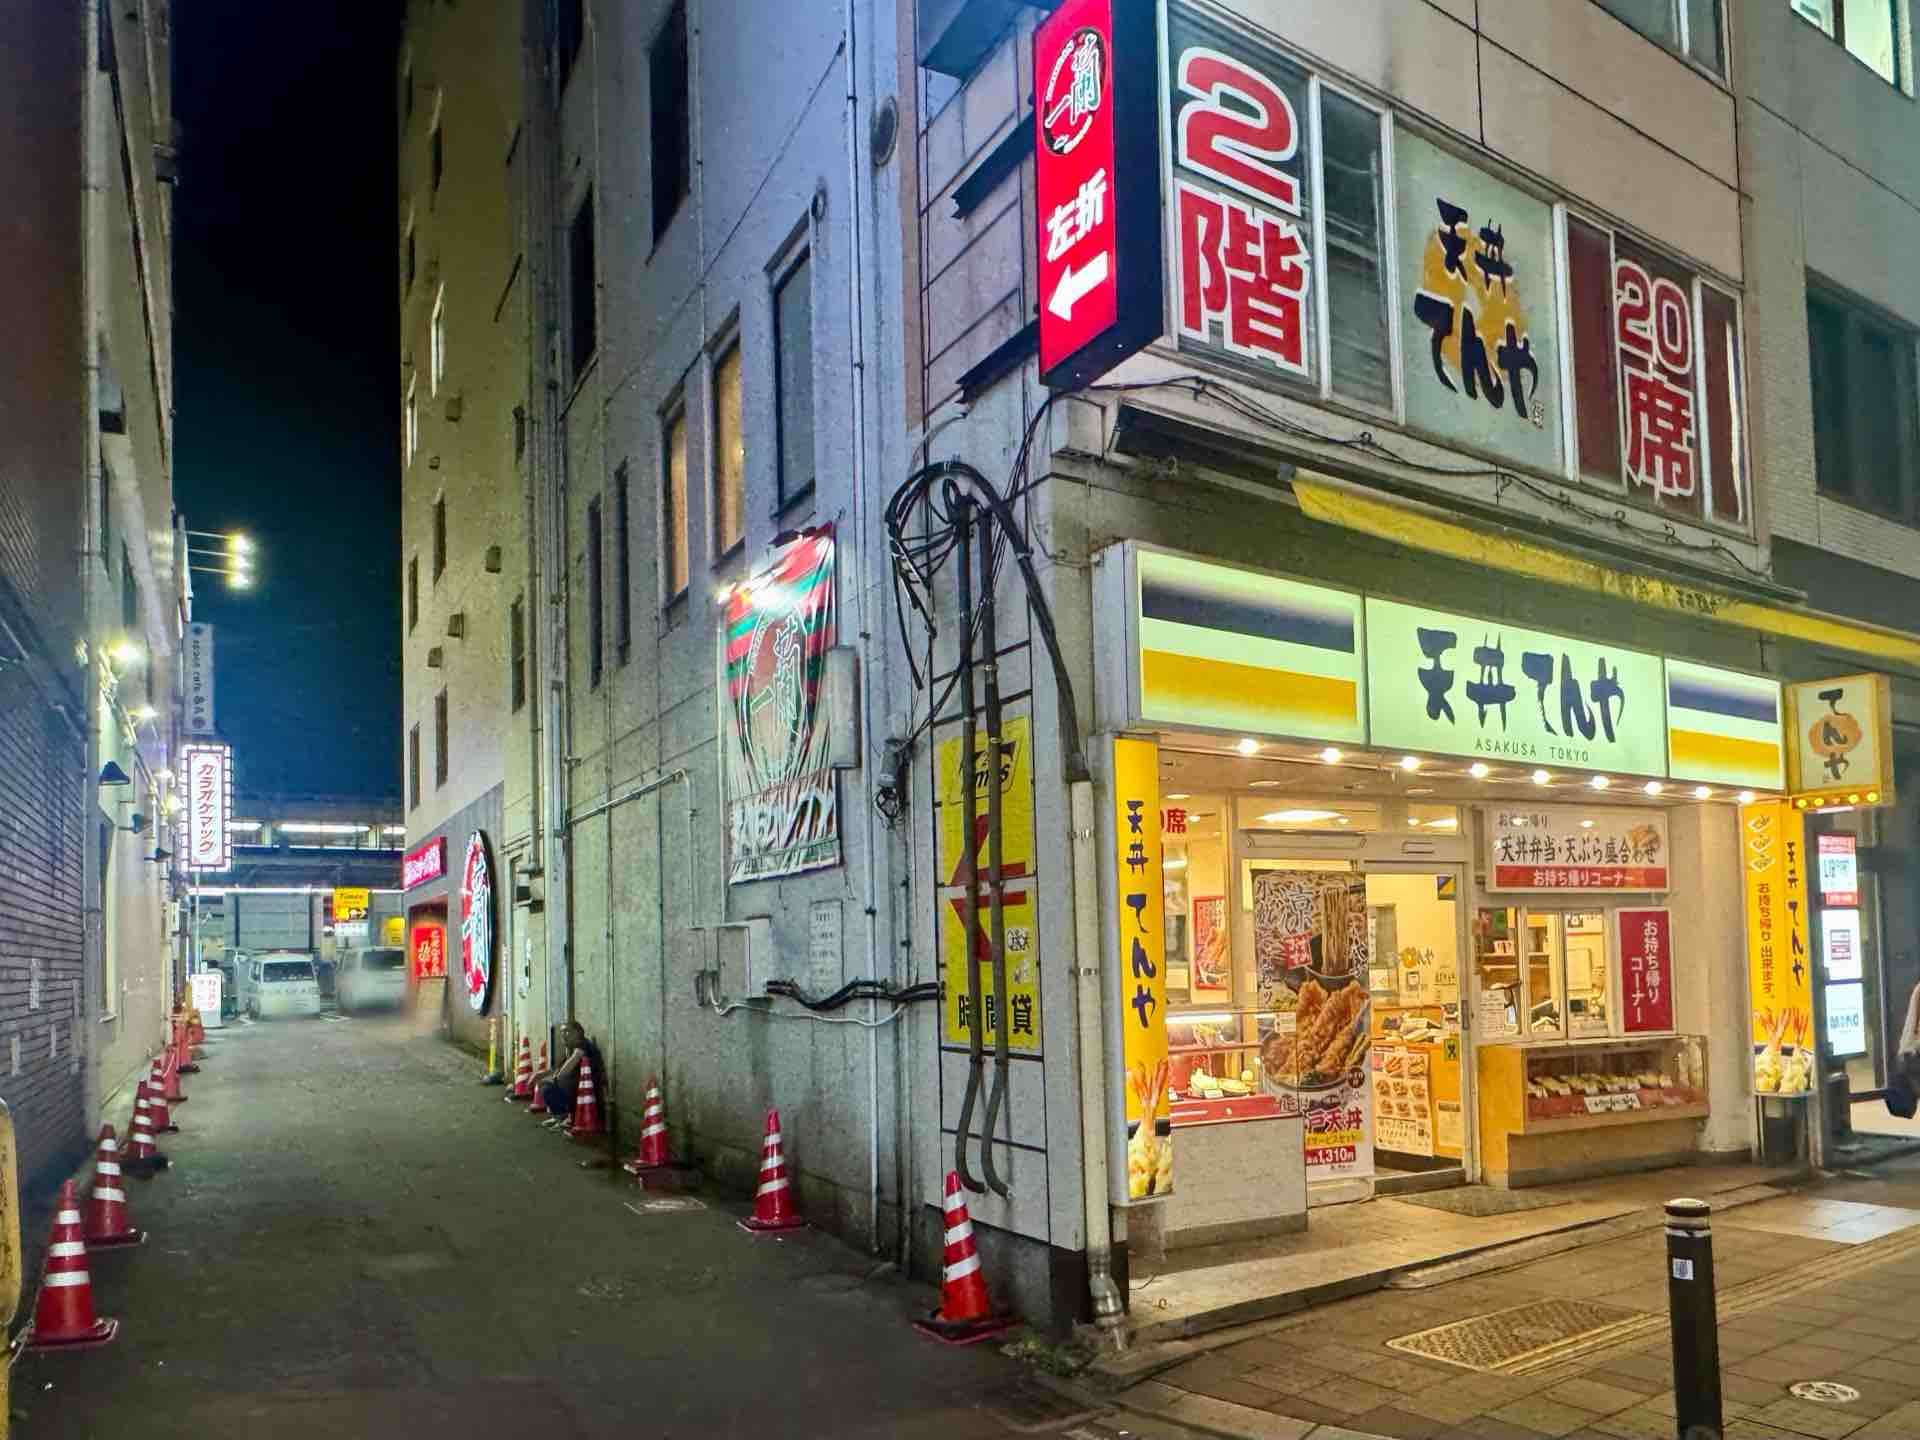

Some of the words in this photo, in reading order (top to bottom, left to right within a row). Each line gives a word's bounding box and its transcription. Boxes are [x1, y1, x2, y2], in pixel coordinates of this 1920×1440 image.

[1048, 168, 1107, 262] 左折
[1176, 48, 1310, 375] 2階
[1414, 292, 1539, 420] てんや
[1614, 259, 1697, 502] 20席
[1416, 625, 1625, 744] 天丼てんや
[1475, 738, 1537, 759] ASAKUSA
[1550, 746, 1590, 763] TOKYO
[1817, 688, 1850, 781] てんや
[1127, 799, 1157, 1029] 天丼てんや
[1533, 869, 1634, 886] お持ち帰りコーナー
[1631, 956, 1646, 1024] コーナー
[1643, 919, 1661, 1005] お持ち帰り
